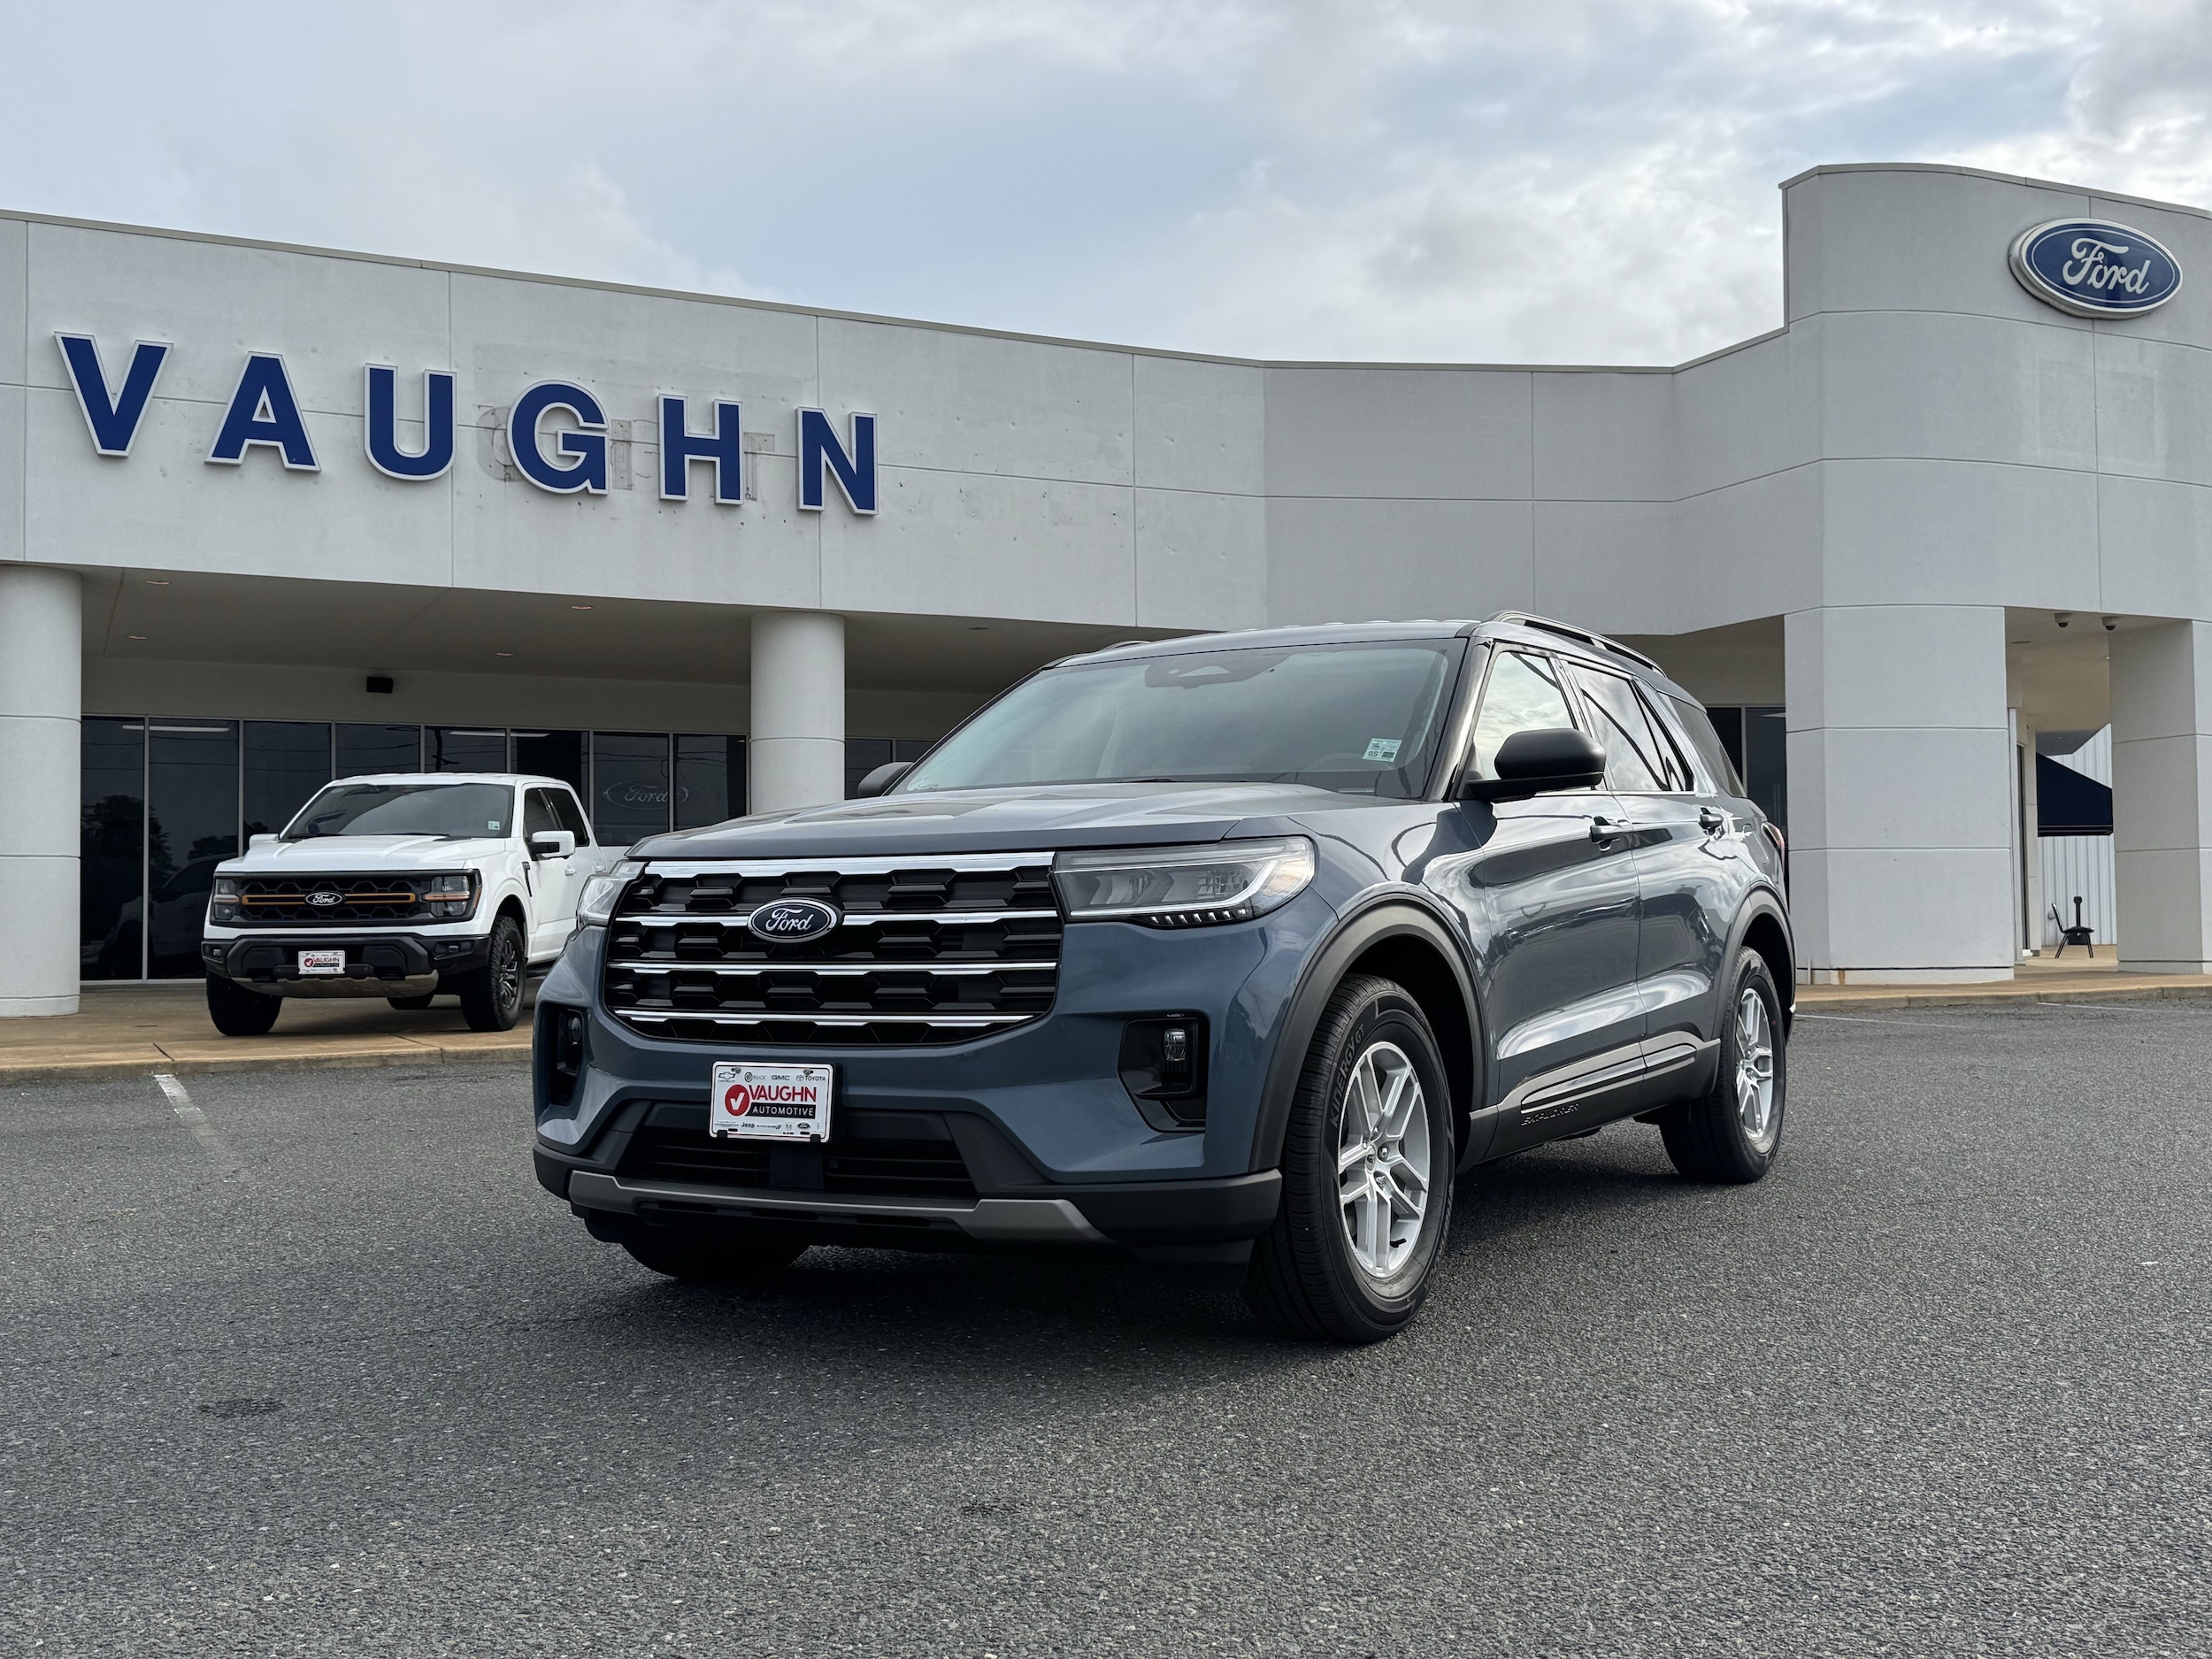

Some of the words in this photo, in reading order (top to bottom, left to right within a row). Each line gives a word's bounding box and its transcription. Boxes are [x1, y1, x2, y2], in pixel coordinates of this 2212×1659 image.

[2062, 237, 2151, 295] Ford
[54, 331, 879, 515] VAUGHN
[624, 784, 668, 803] Ford
[312, 894, 335, 903] Ford
[765, 908, 814, 932] Ford
[1329, 1036, 1356, 1129] KINERGY
[1355, 1025, 1365, 1044] GT
[749, 1085, 817, 1102] VAUGHN
[752, 1106, 814, 1116] AUTOMOTIVE
